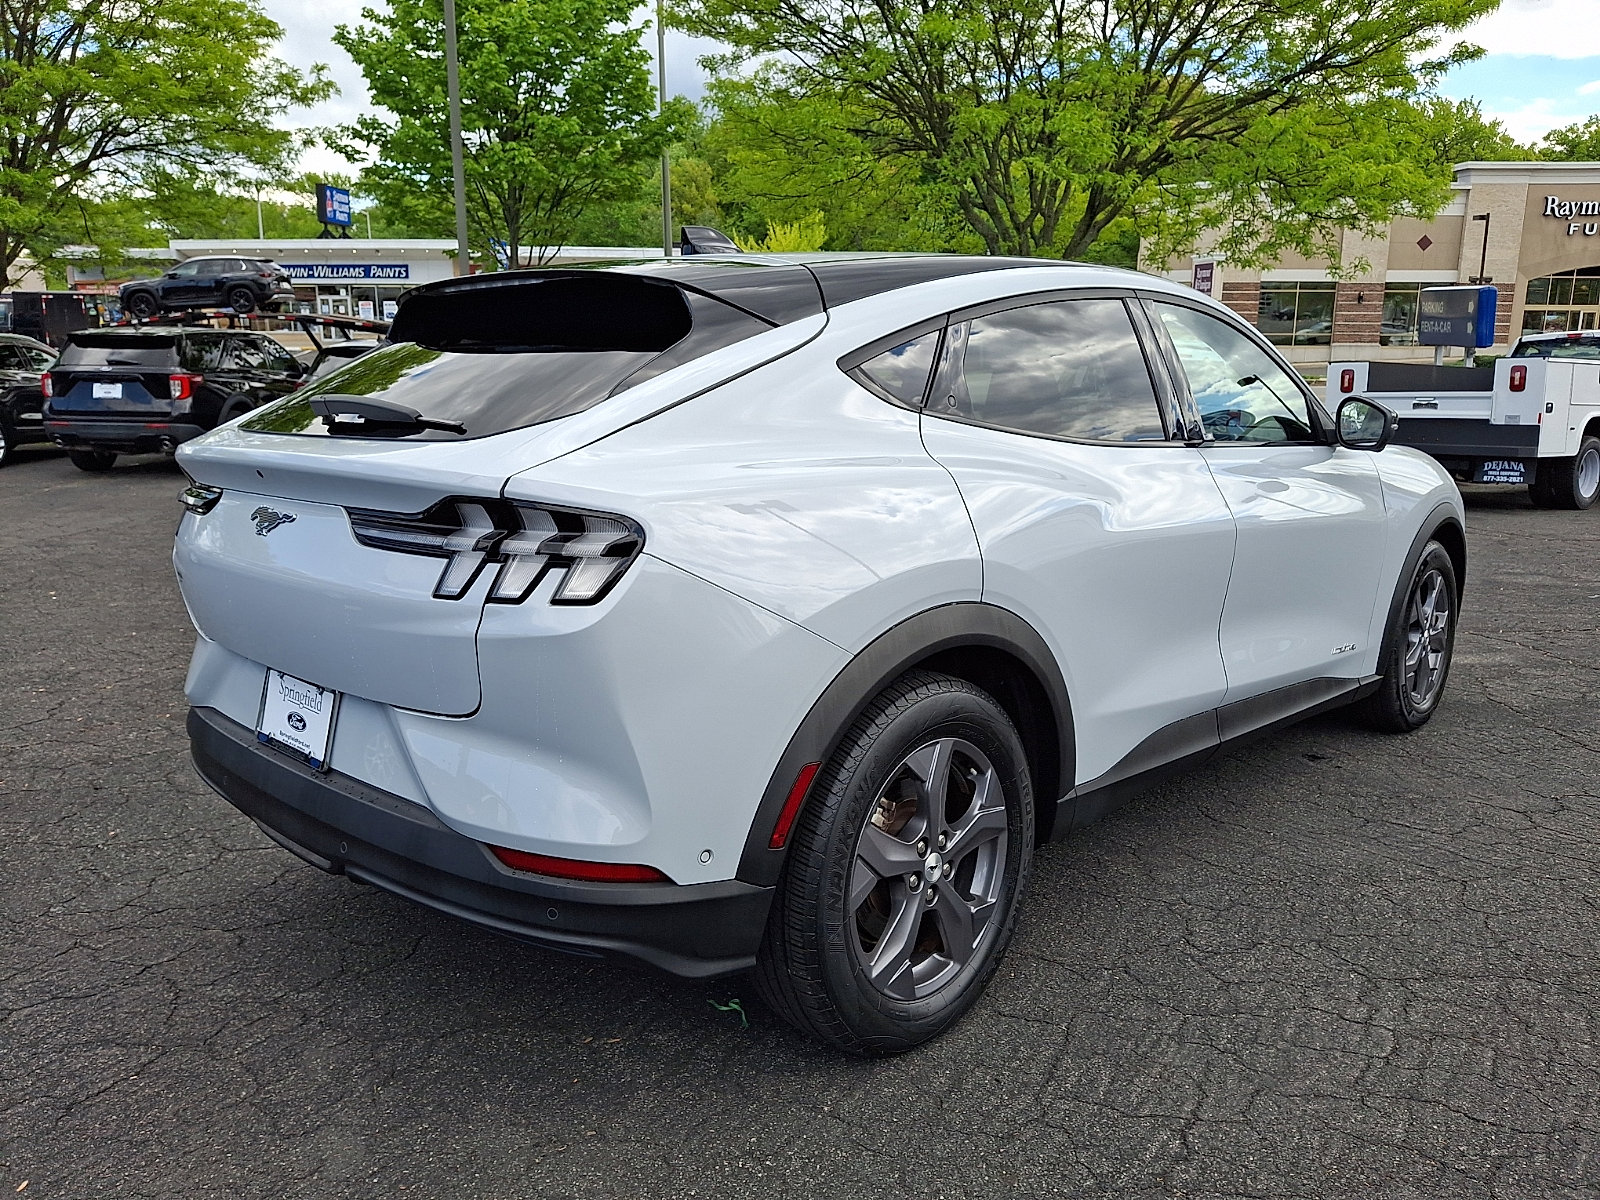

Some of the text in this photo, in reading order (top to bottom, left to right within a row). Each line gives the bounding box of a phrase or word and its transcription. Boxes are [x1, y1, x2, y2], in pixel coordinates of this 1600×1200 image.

[1544, 195, 1600, 220] Raym
[1568, 222, 1600, 236] FU
[284, 265, 407, 278] WIN-WILLIAMS PAINTS
[1421, 301, 1444, 314] PARKING
[1420, 321, 1452, 333] RENT-A-CAR
[1483, 460, 1526, 472] DEJANA
[278, 679, 323, 712] Springfield
[289, 713, 305, 729] Ford
